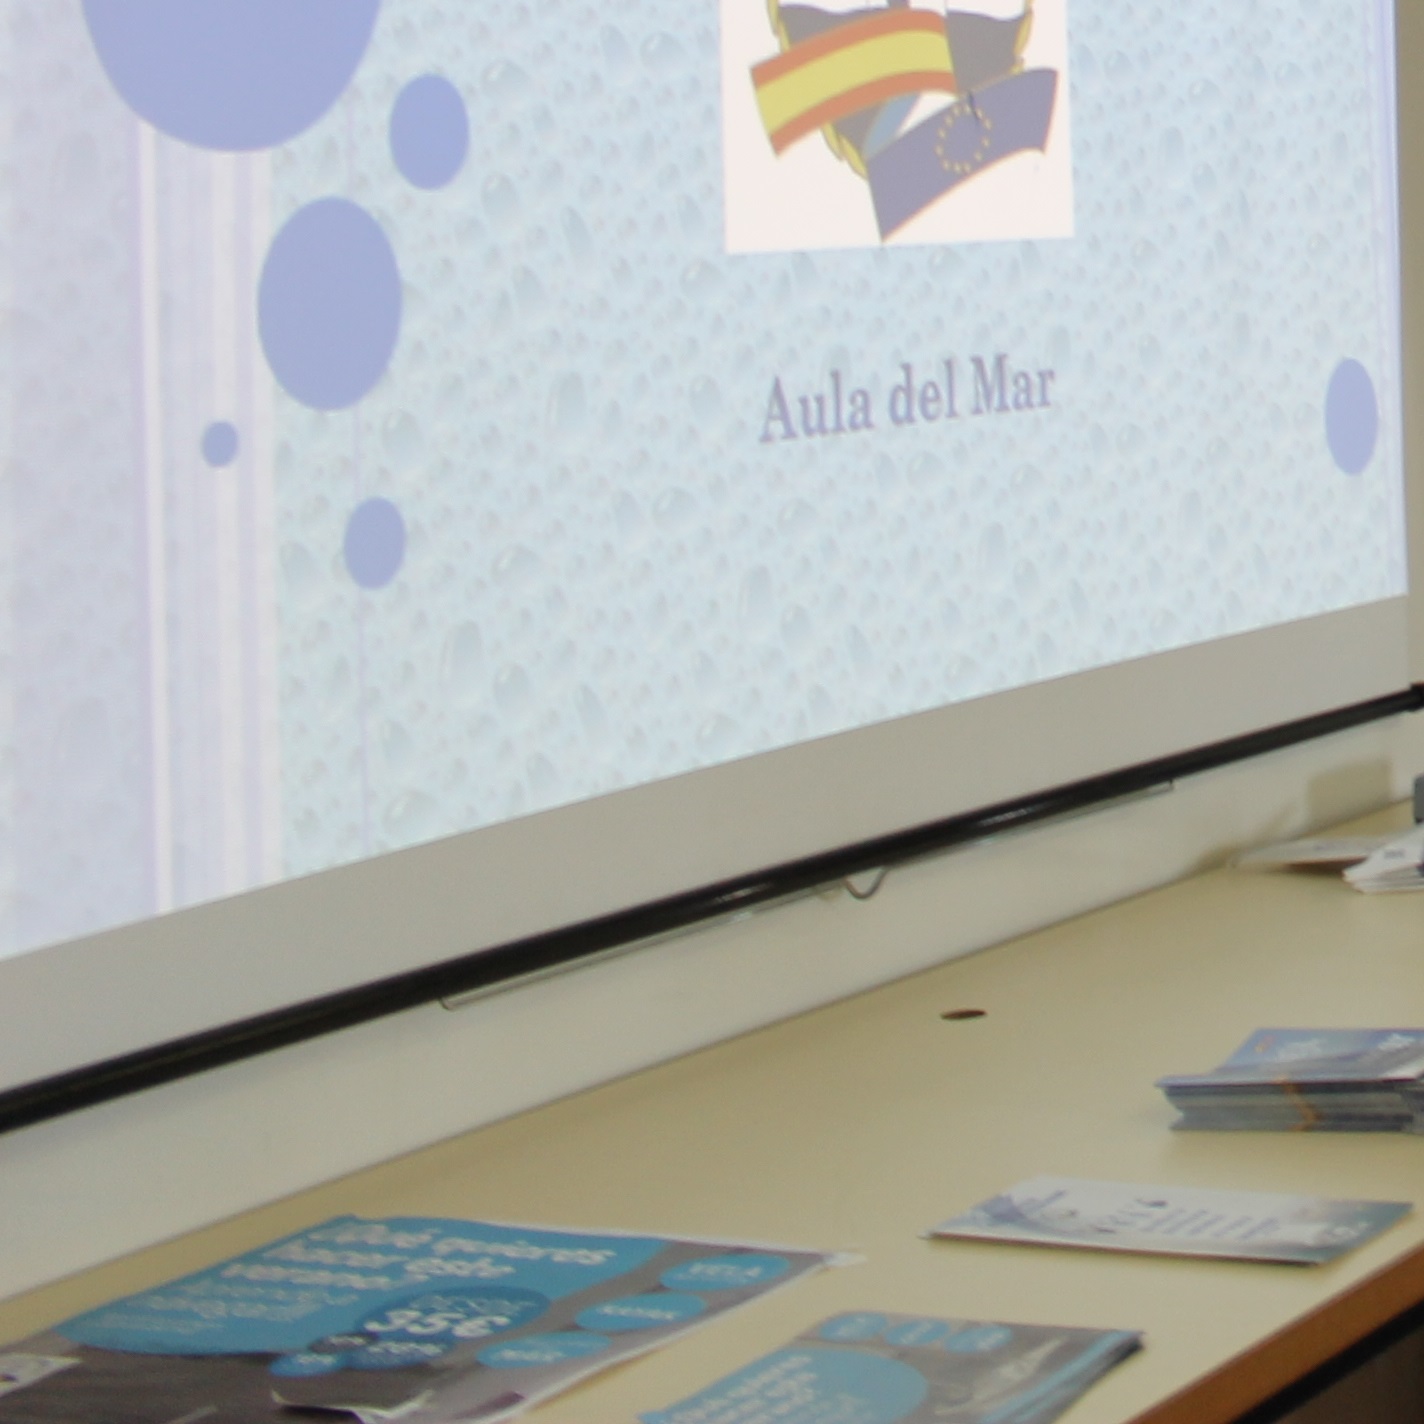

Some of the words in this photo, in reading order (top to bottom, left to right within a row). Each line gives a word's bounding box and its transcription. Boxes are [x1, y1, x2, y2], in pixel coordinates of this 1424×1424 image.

[758, 368, 876, 444] Aula
[888, 358, 960, 427] del
[969, 352, 1057, 416] Mar
